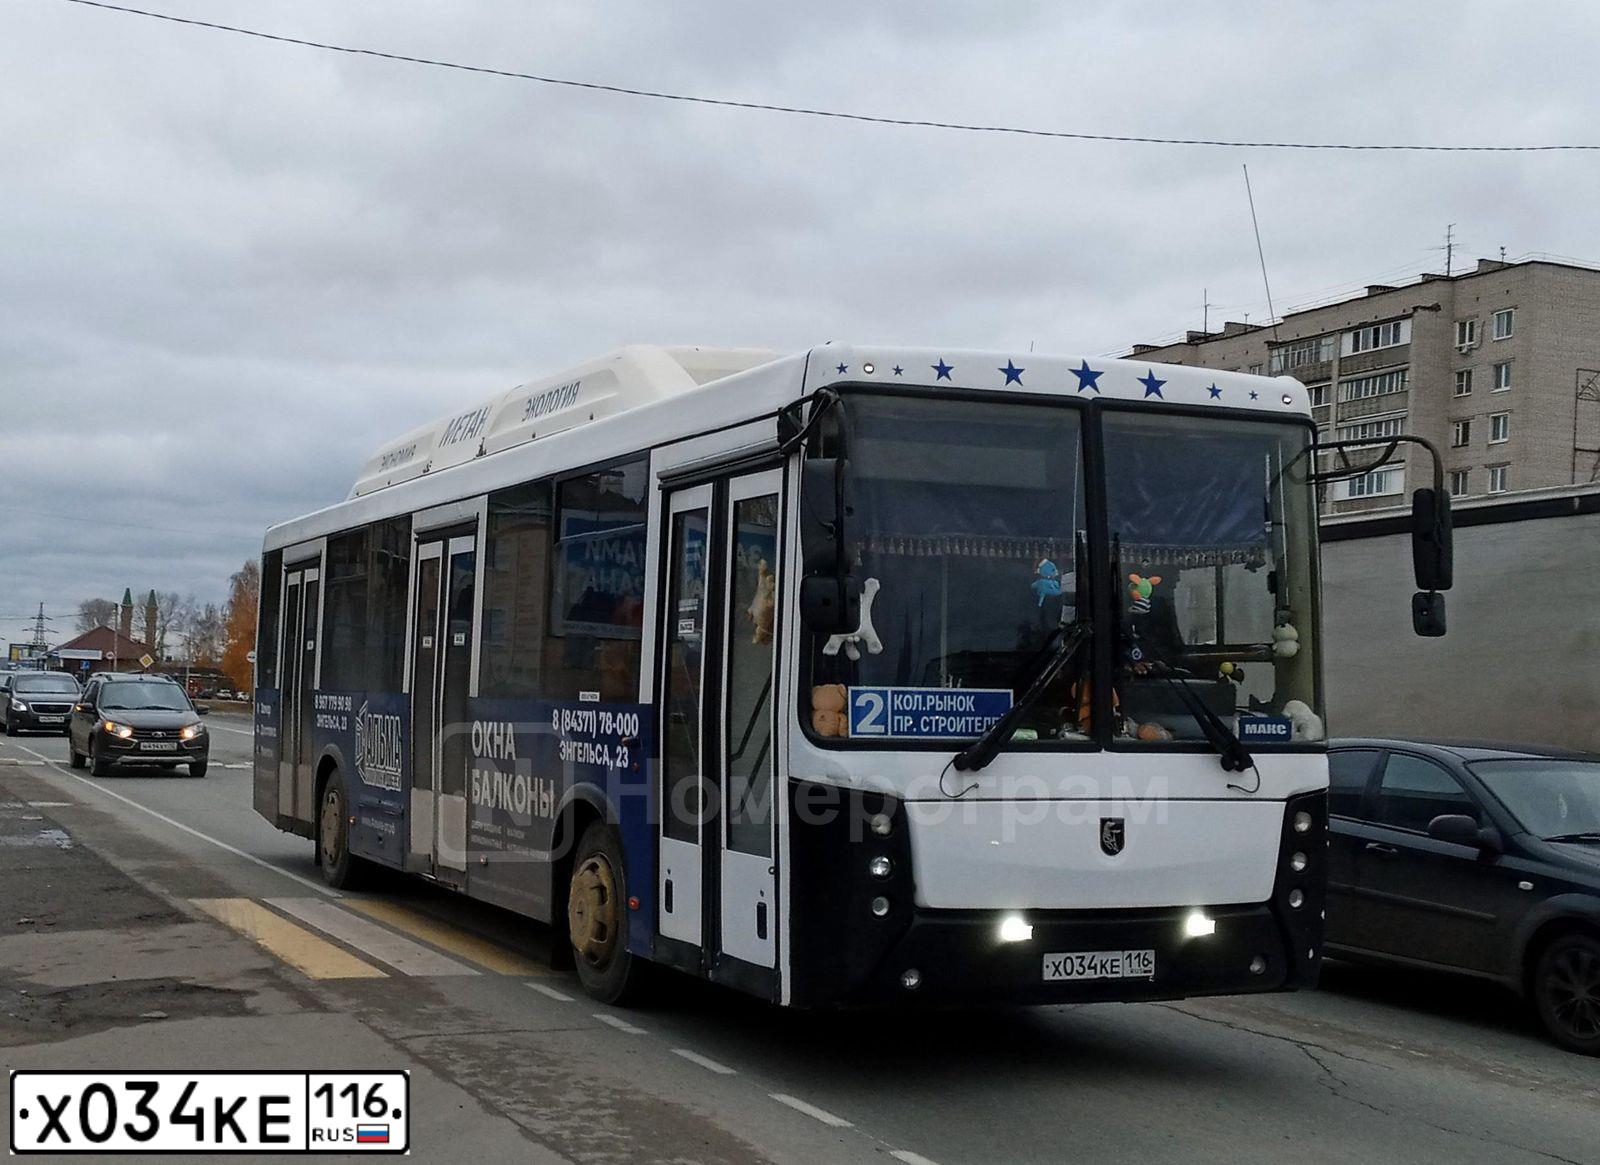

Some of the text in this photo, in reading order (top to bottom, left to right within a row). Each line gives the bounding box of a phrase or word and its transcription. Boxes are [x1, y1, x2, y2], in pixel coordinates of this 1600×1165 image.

[522, 380, 581, 423] ЭКОЛОГИЯ
[438, 403, 493, 449] МЕТАН
[855, 692, 885, 733] 2
[893, 694, 975, 712] КОЛ.РЫНОК
[552, 708, 639, 739] 8 (84371) 78-000
[893, 714, 1001, 733] ПР. СТРОИТЕЛ
[1244, 723, 1288, 736] МАКС
[471, 719, 517, 761] ОКНА
[558, 739, 630, 771] ЭНГЕЛЬСА, 23
[471, 768, 555, 820] БАЛКОНЫ
[1051, 951, 1150, 978] Х034КЕ 116
